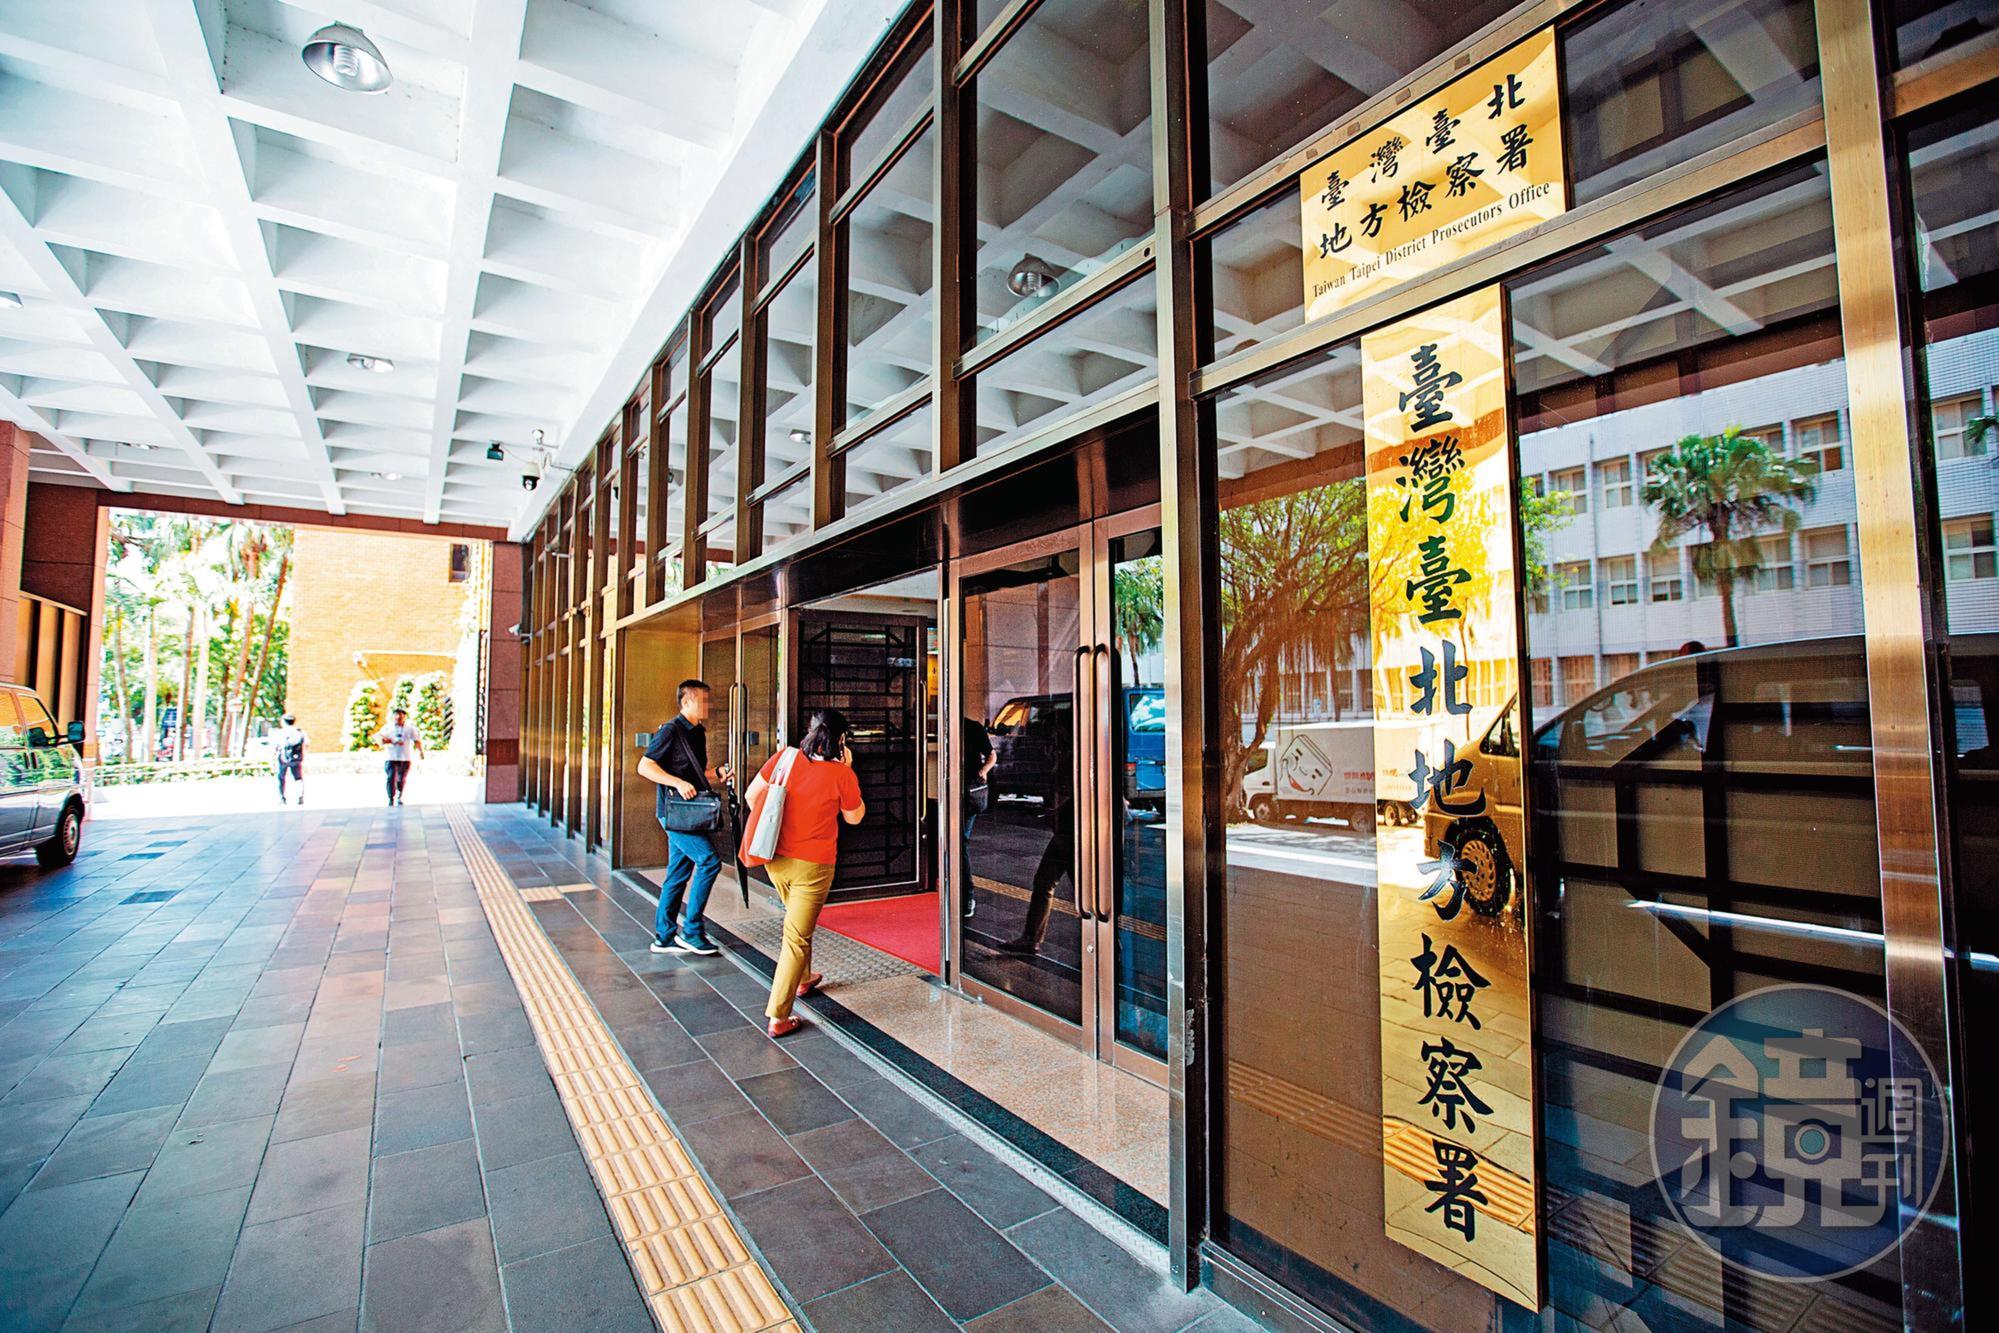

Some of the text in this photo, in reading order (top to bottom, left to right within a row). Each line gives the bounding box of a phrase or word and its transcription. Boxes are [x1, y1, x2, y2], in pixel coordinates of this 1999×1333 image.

[1319, 123, 1534, 259] 地方檢察署
[1320, 74, 1526, 211] 臺灣臺北
[1312, 182, 1550, 298] Taiwan Taipei District Prosecutors Office
[1398, 343, 1494, 1243] 臺灣臺北地方檢察署
